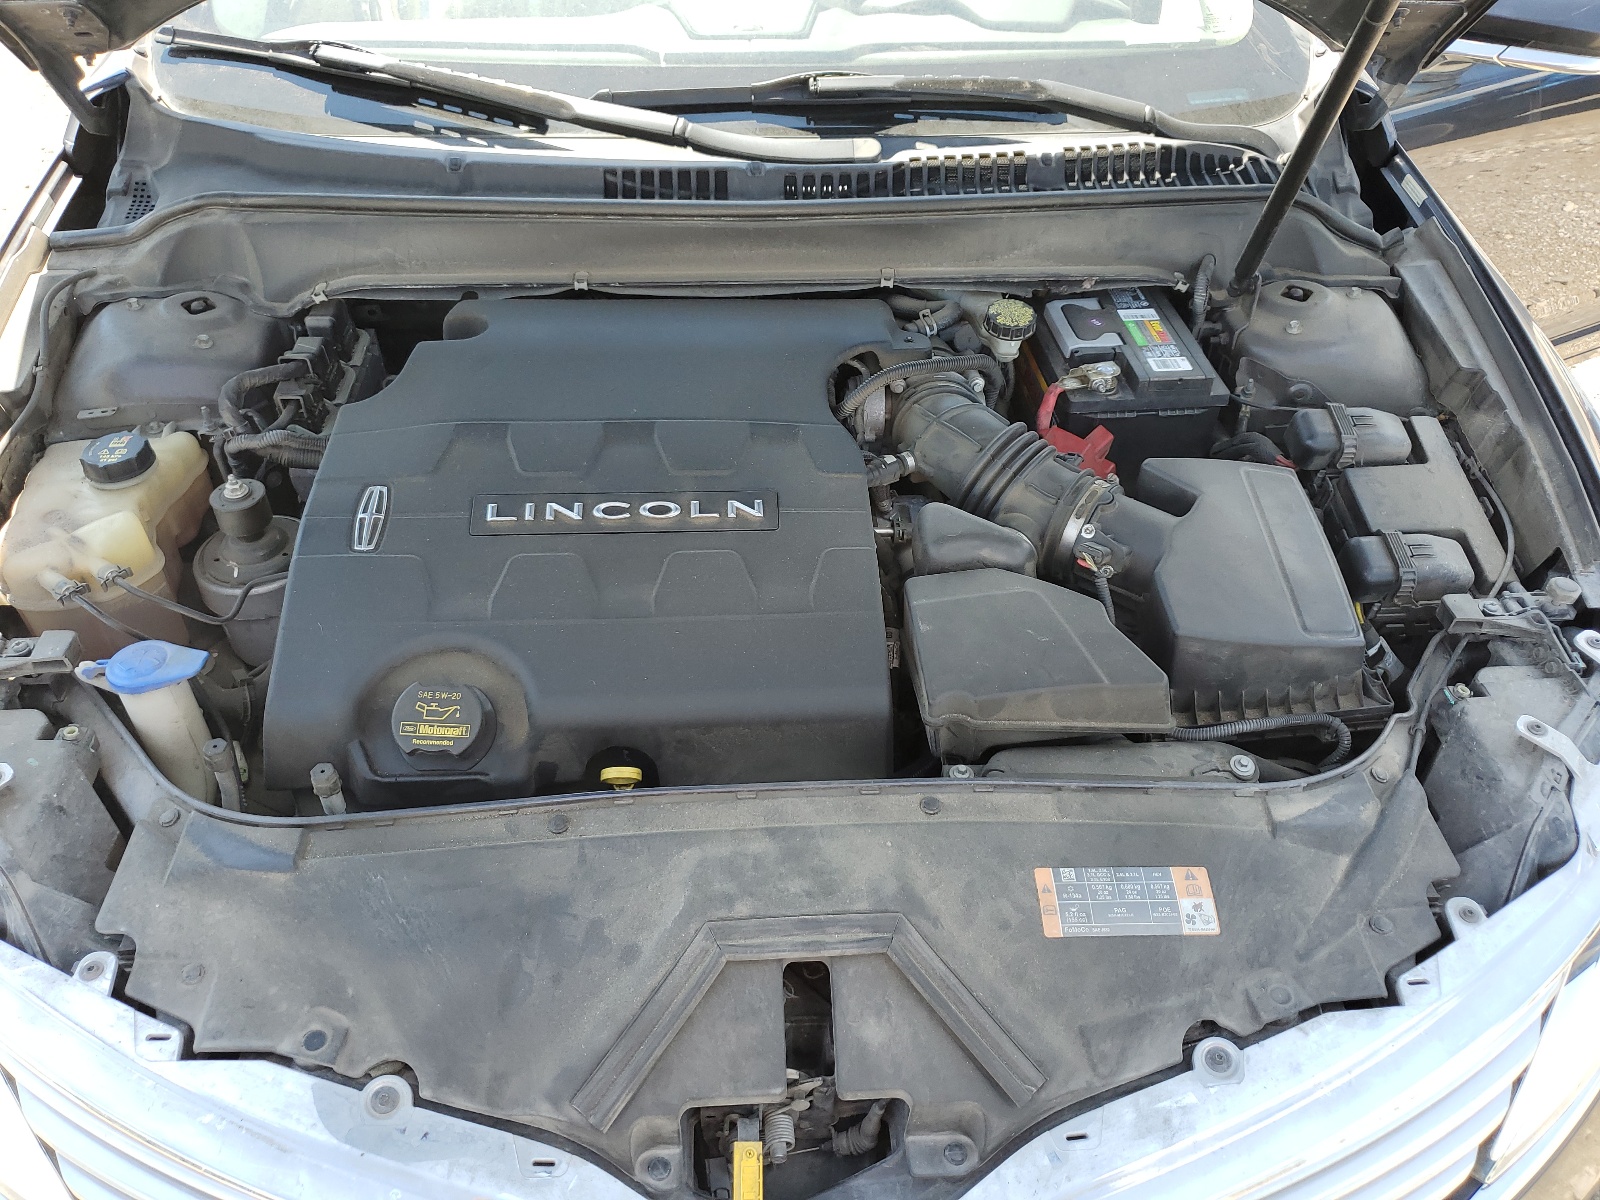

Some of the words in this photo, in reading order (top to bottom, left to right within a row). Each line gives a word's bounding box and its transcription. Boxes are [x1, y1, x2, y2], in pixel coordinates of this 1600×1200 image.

[486, 499, 764, 521] LINCOLN
[435, 692, 461, 700] 5W-20
[420, 725, 467, 736] Motorcraft
